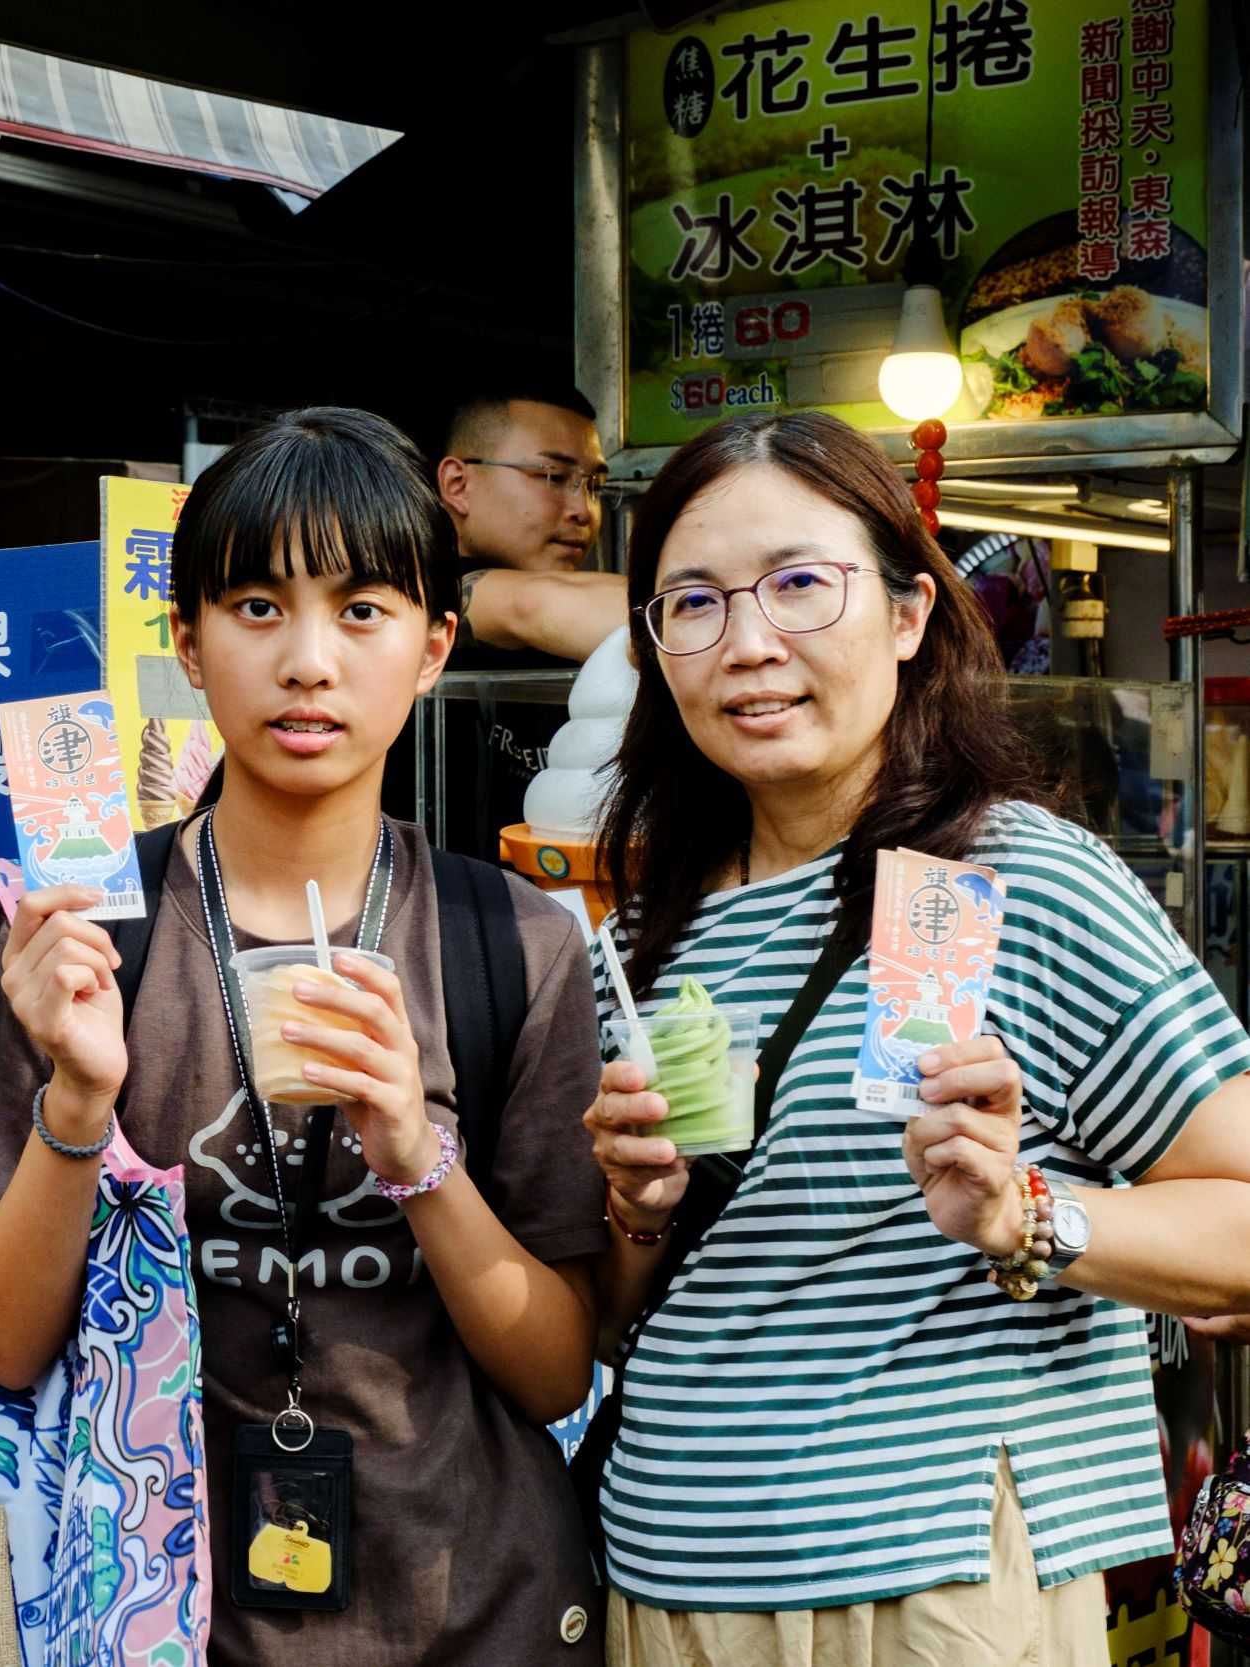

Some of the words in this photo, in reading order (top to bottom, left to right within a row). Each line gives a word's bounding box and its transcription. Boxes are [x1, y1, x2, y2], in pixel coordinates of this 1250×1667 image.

[673, 45, 707, 127] 焦糖
[720, 0, 1034, 120] 花生捲
[1079, 17, 1120, 281] 新聞採訪報導
[670, 168, 976, 281] 冰淇淋
[735, 301, 811, 347] 60
